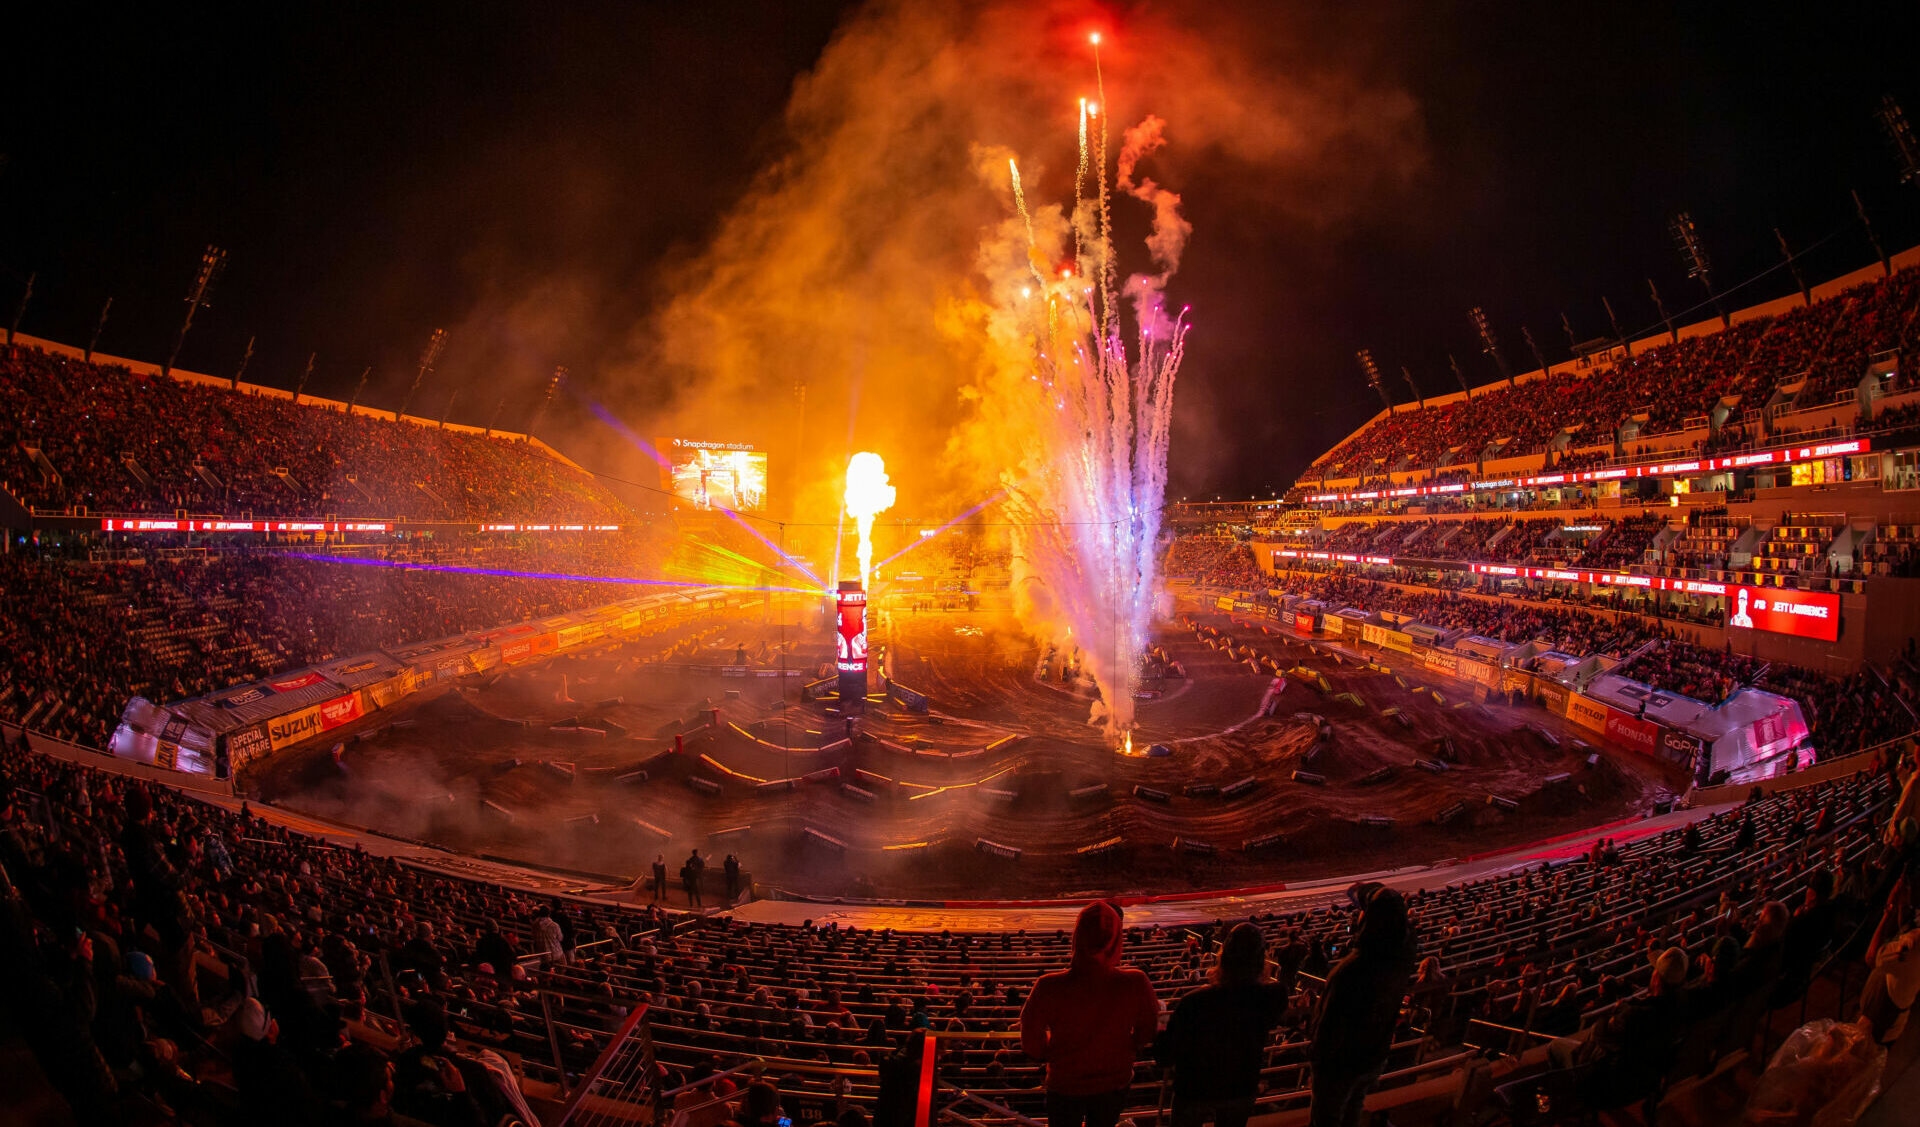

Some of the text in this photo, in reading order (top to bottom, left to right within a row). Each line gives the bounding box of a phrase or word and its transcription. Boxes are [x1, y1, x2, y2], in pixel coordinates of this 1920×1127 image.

[683, 440, 754, 450] Snapdragon stadium
[843, 593, 862, 602] JETT
[1772, 601, 1789, 613] JETT
[1788, 603, 1828, 618] LAWRENCE
[437, 658, 464, 670] GoPro
[1574, 703, 1606, 721] DUNLOP
[271, 711, 321, 742] SUZUKI
[1617, 723, 1654, 745] HONDA
[233, 728, 264, 748] SPECIAL
[234, 738, 270, 760] WARFARE
